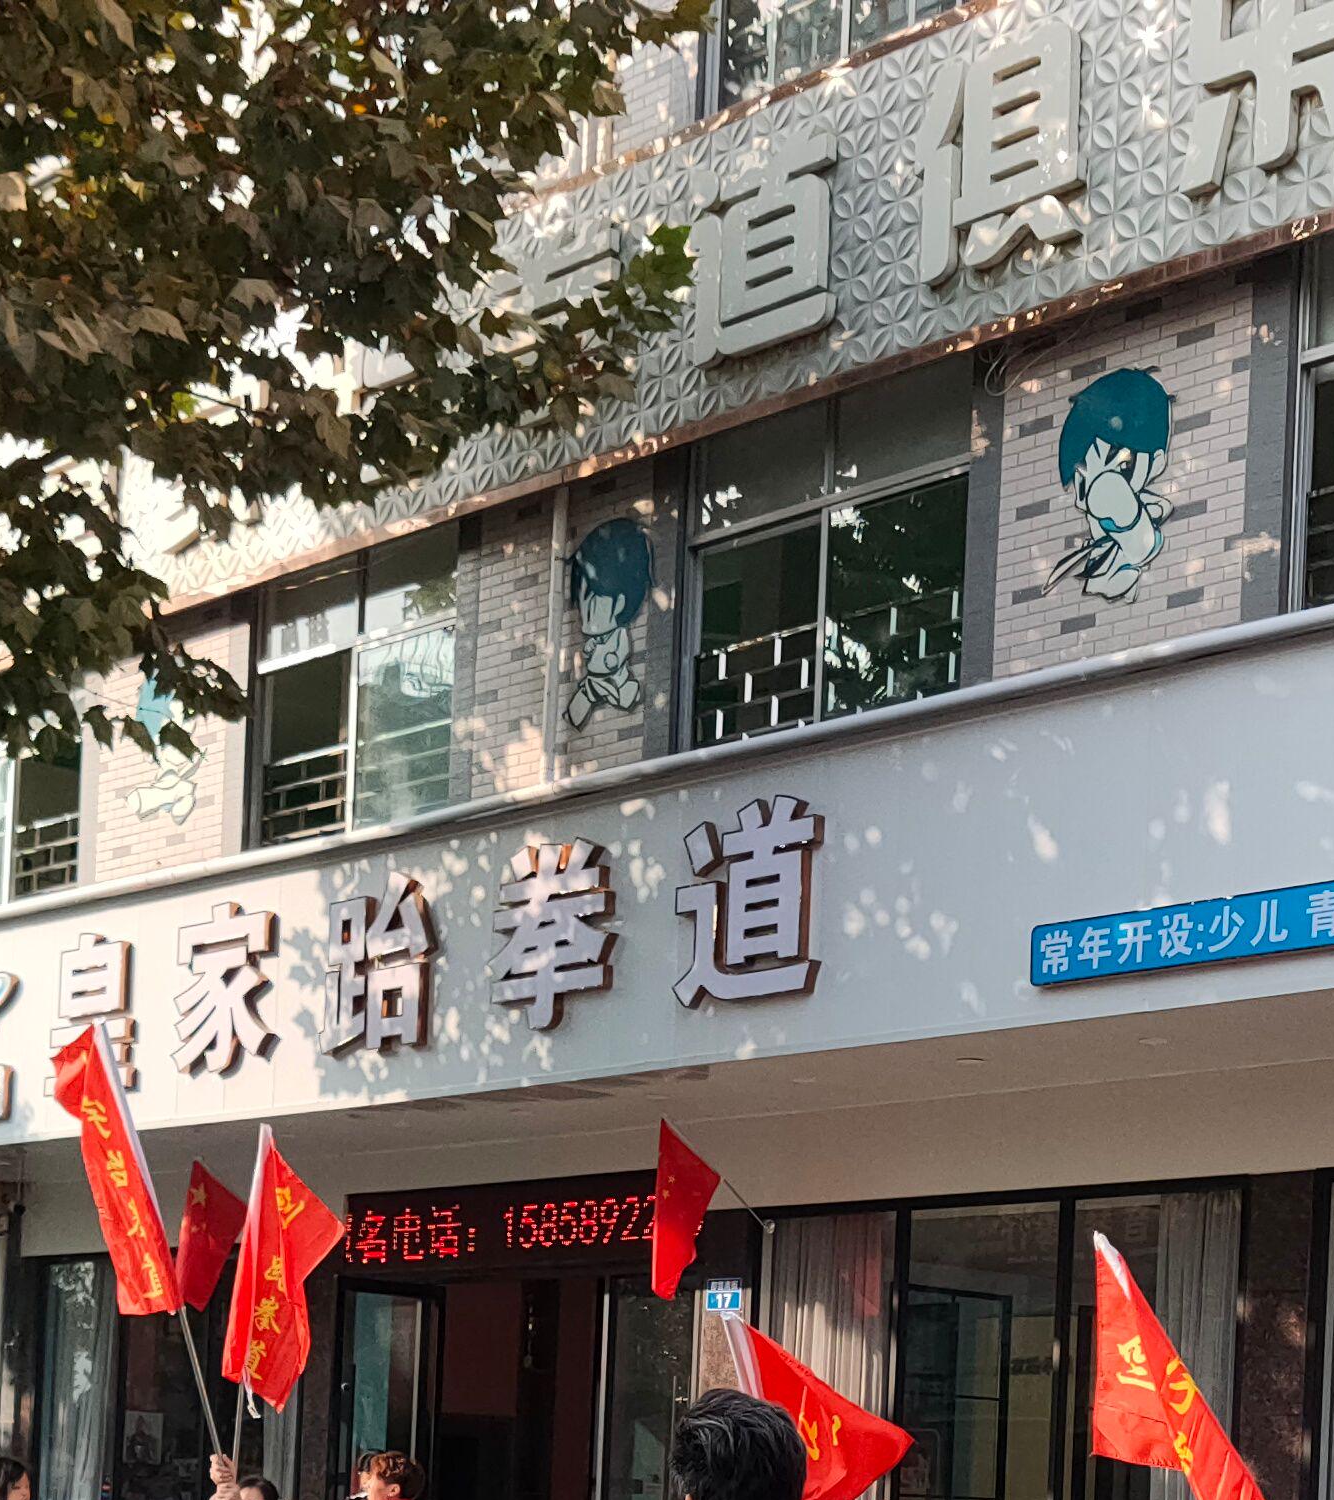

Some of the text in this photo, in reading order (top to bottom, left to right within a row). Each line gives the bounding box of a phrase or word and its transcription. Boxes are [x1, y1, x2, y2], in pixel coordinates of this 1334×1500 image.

[43, 795, 825, 1098] 皇家跆拳道
[502, 1194, 704, 1249] 15858922
[715, 1293, 733, 1309] 17
